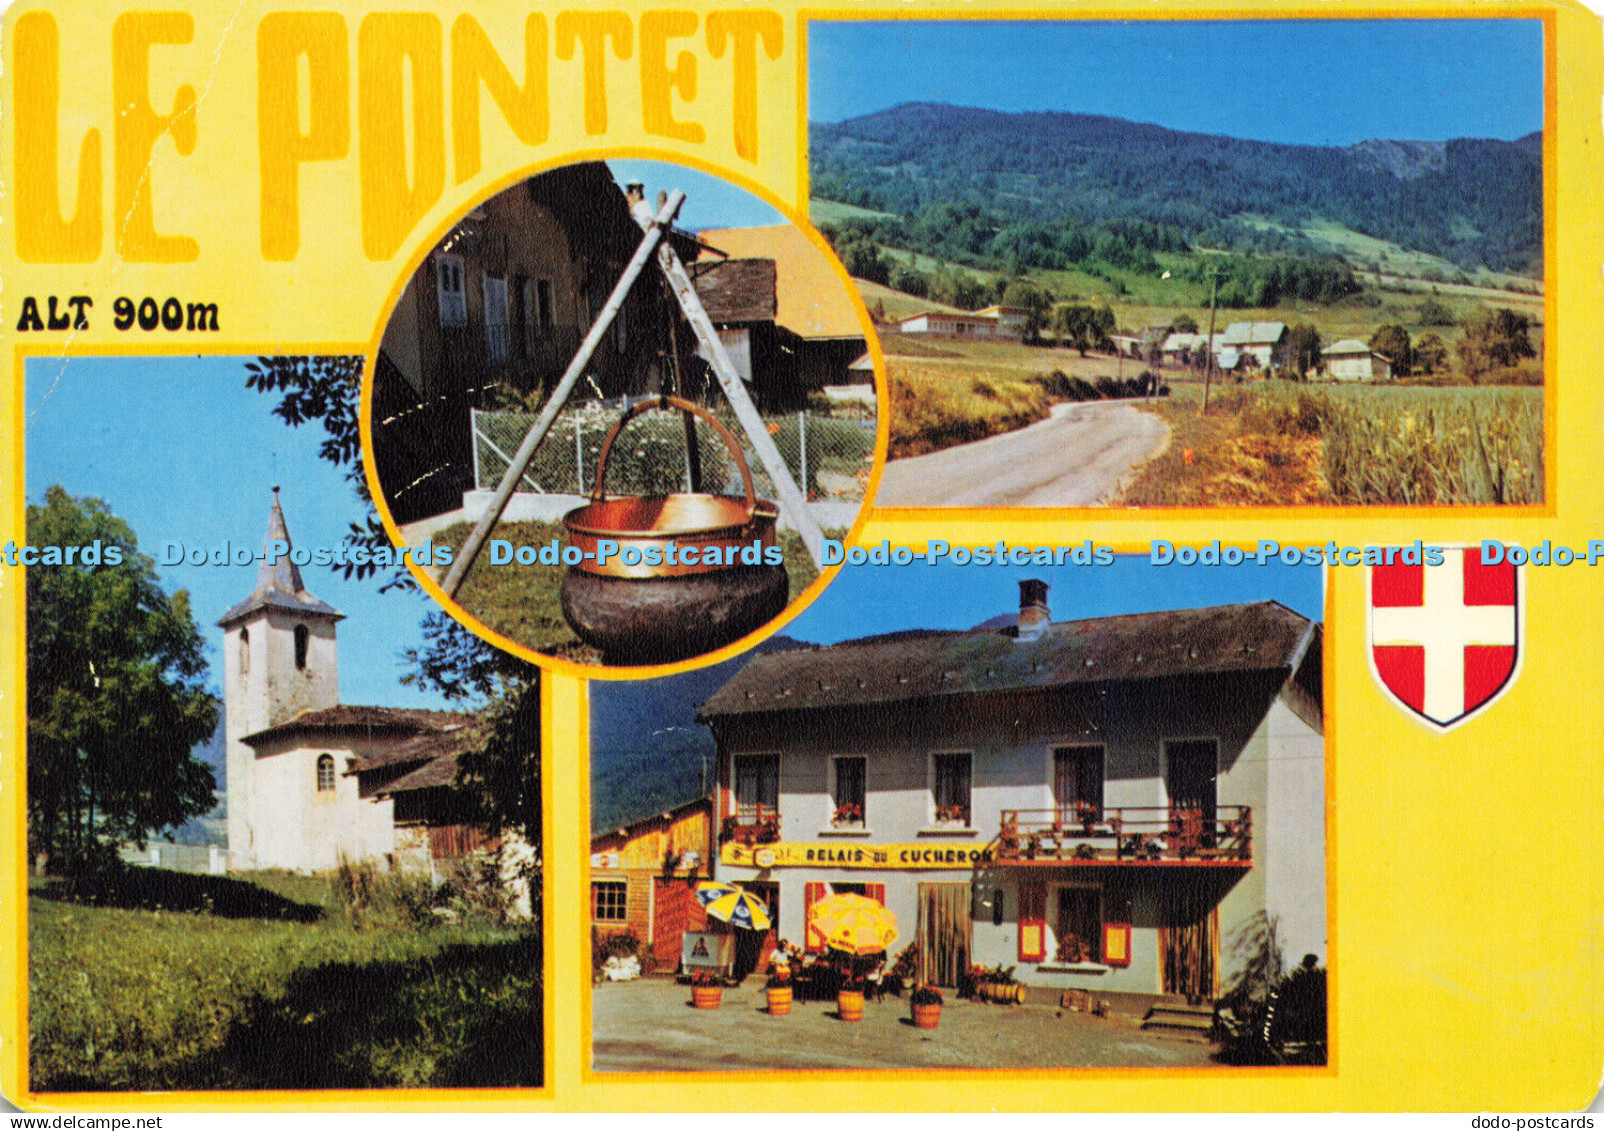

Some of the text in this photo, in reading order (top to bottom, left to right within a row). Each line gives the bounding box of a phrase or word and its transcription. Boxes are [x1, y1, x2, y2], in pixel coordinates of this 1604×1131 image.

[13, 9, 784, 264] LE PONTET
[16, 297, 220, 332] ALT 900m
[806, 849, 864, 863] RELAIS
[873, 851, 888, 864] DU
[900, 849, 993, 863] CUCHERON
